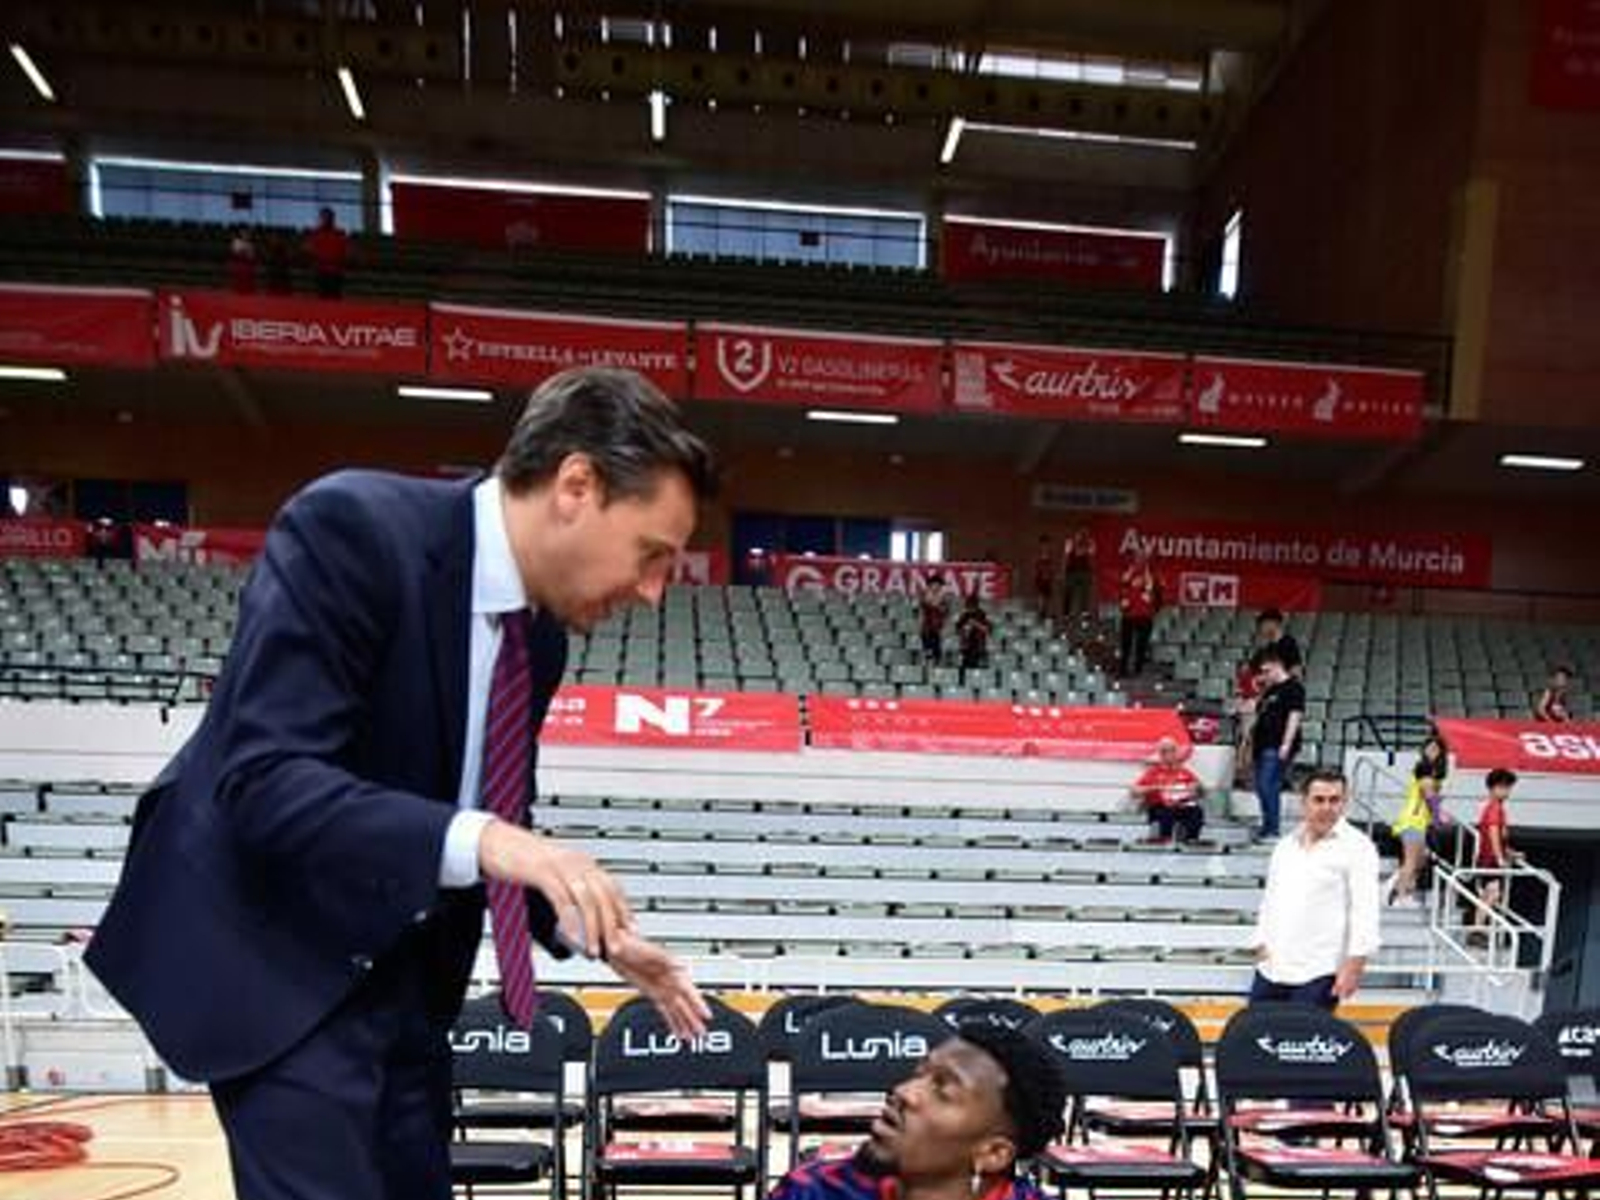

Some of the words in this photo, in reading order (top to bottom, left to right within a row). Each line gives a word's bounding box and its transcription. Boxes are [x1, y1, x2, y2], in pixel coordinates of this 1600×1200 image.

[231, 318, 327, 344] IBERIA
[332, 325, 417, 347] VITAE
[1119, 528, 1320, 562] Ayuntamiento
[1327, 541, 1362, 566] de
[1369, 543, 1464, 574] Murcia
[834, 565, 998, 598] GRANATE
